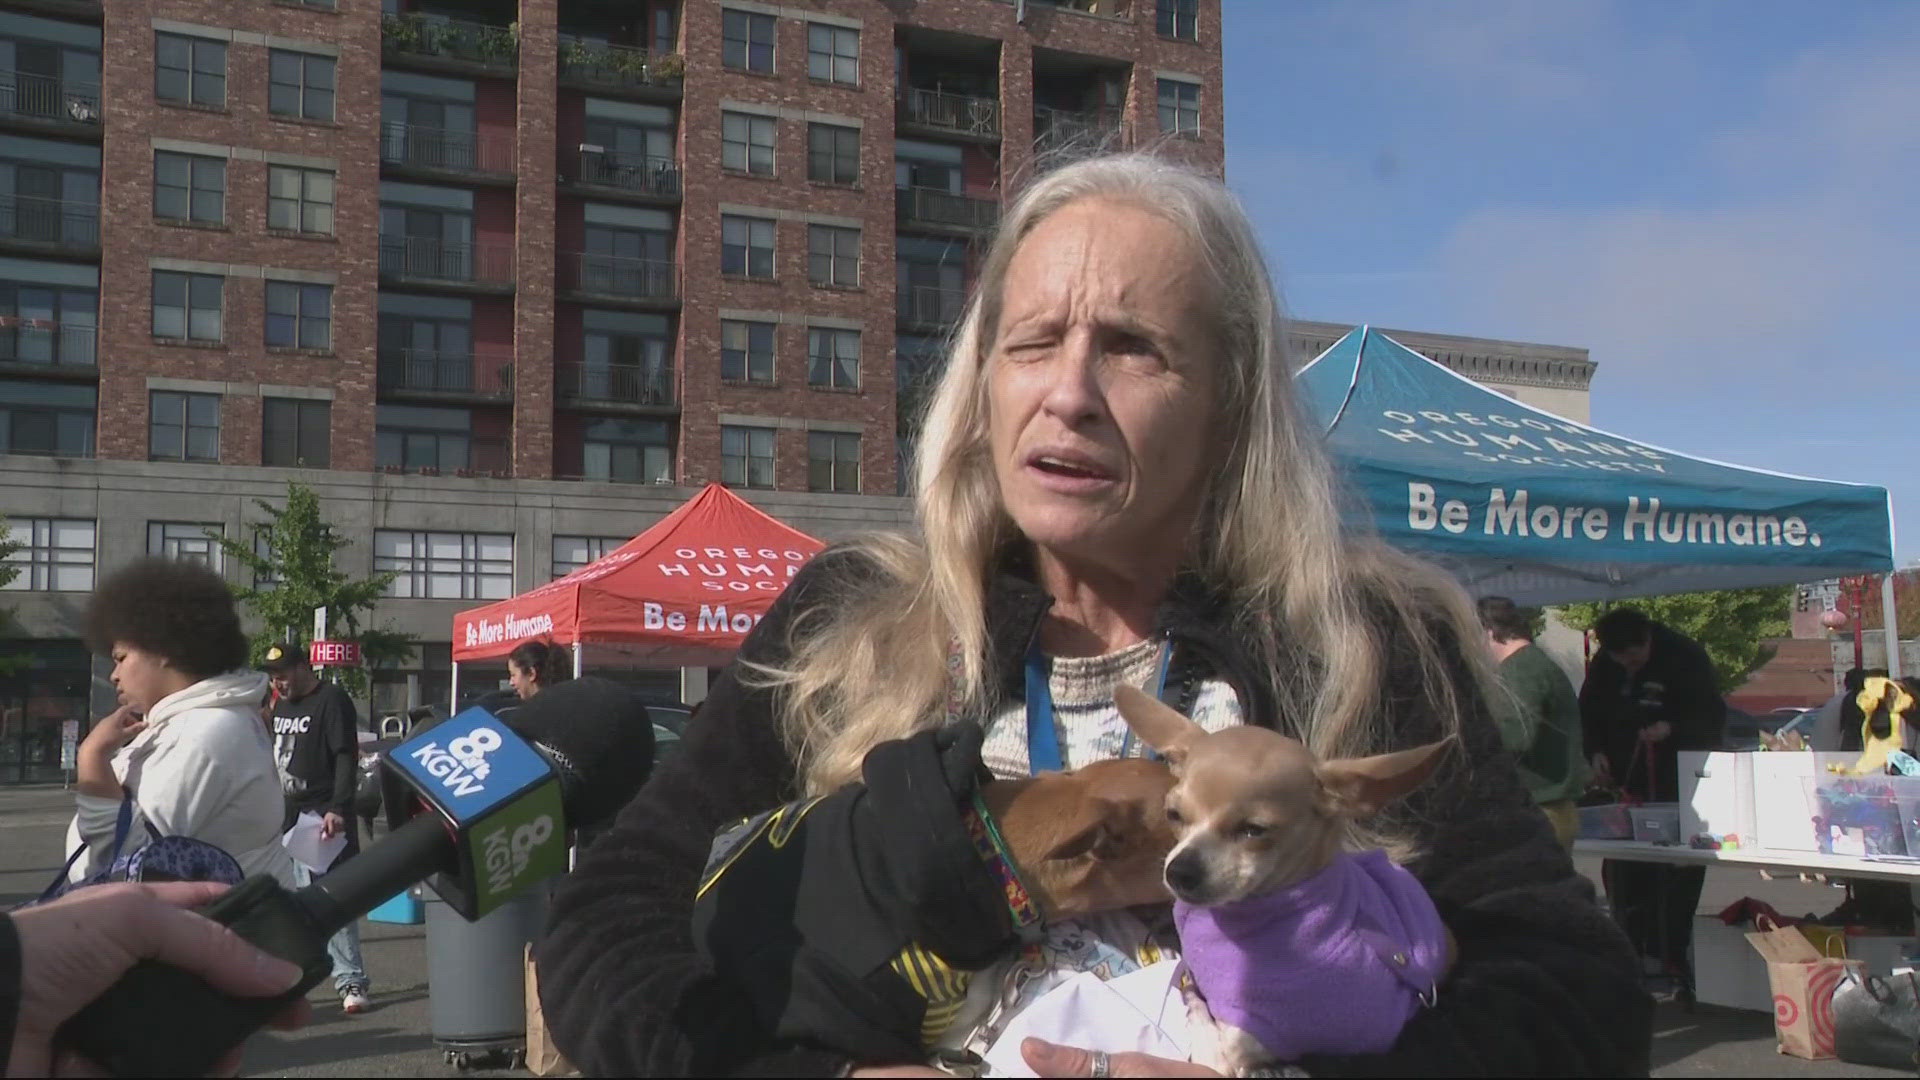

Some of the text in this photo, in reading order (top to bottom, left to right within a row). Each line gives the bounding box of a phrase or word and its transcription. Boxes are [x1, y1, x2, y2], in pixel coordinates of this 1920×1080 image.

[1383, 410, 1589, 436] OREGON
[1378, 428, 1667, 461] HUMANE
[1463, 451, 1667, 474] SOCIETY
[1408, 482, 1822, 548] Be More Humane.
[675, 547, 815, 561] OREGO
[701, 581, 789, 592] SOC
[465, 621, 479, 648] Be
[478, 618, 504, 645] More
[643, 602, 765, 634] Be Mo
[316, 643, 353, 662] HERE
[411, 741, 485, 798] KGW
[483, 826, 513, 896] KGW
